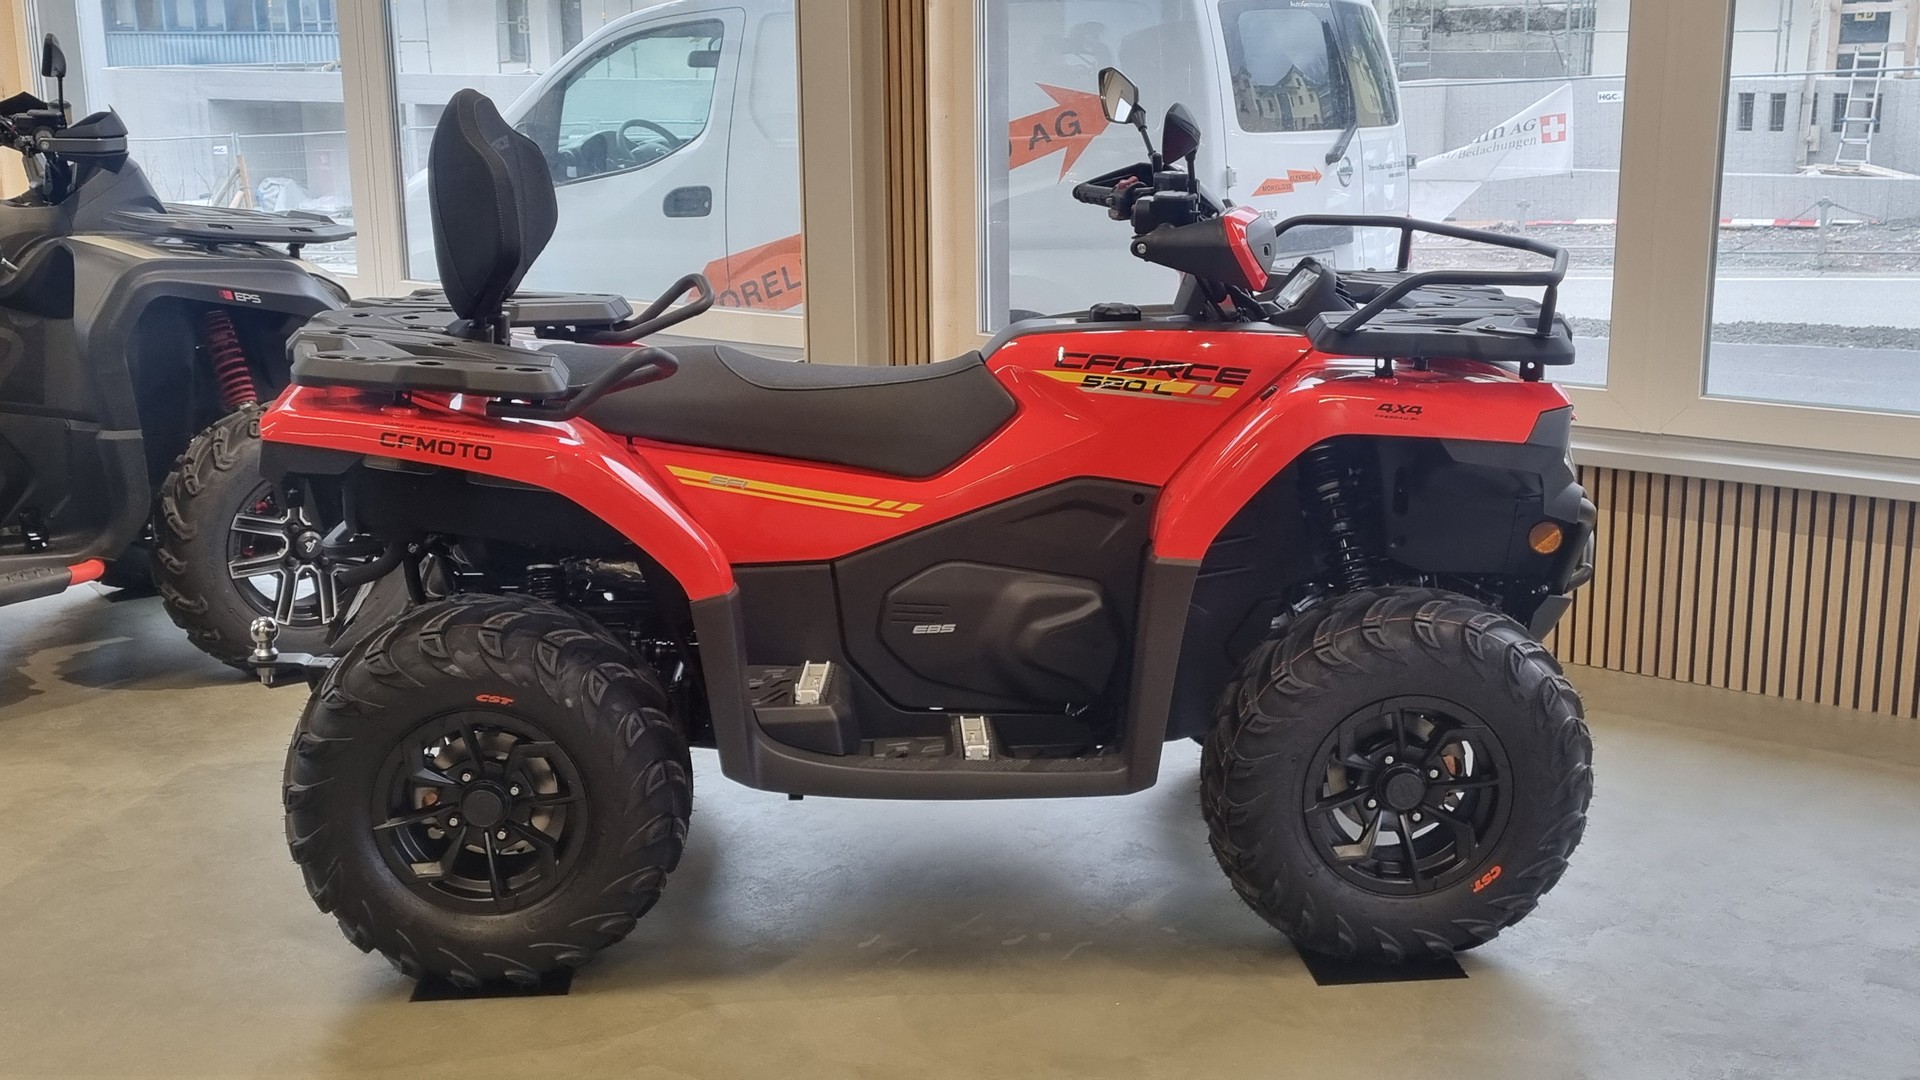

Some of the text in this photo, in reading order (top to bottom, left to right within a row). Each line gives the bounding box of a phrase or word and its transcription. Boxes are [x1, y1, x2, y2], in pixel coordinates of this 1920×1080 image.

[1028, 110, 1082, 151] AG
[1510, 118, 1537, 136] AG
[1458, 137, 1537, 159] Bedachungen
[719, 258, 802, 308] OREL
[234, 291, 262, 304] EPS
[1054, 352, 1252, 386] CFORCE
[1081, 375, 1148, 392] 520
[380, 432, 492, 461] CFMOTO
[912, 623, 957, 634] EBS
[475, 694, 514, 705] CST
[1473, 865, 1502, 893] CST
